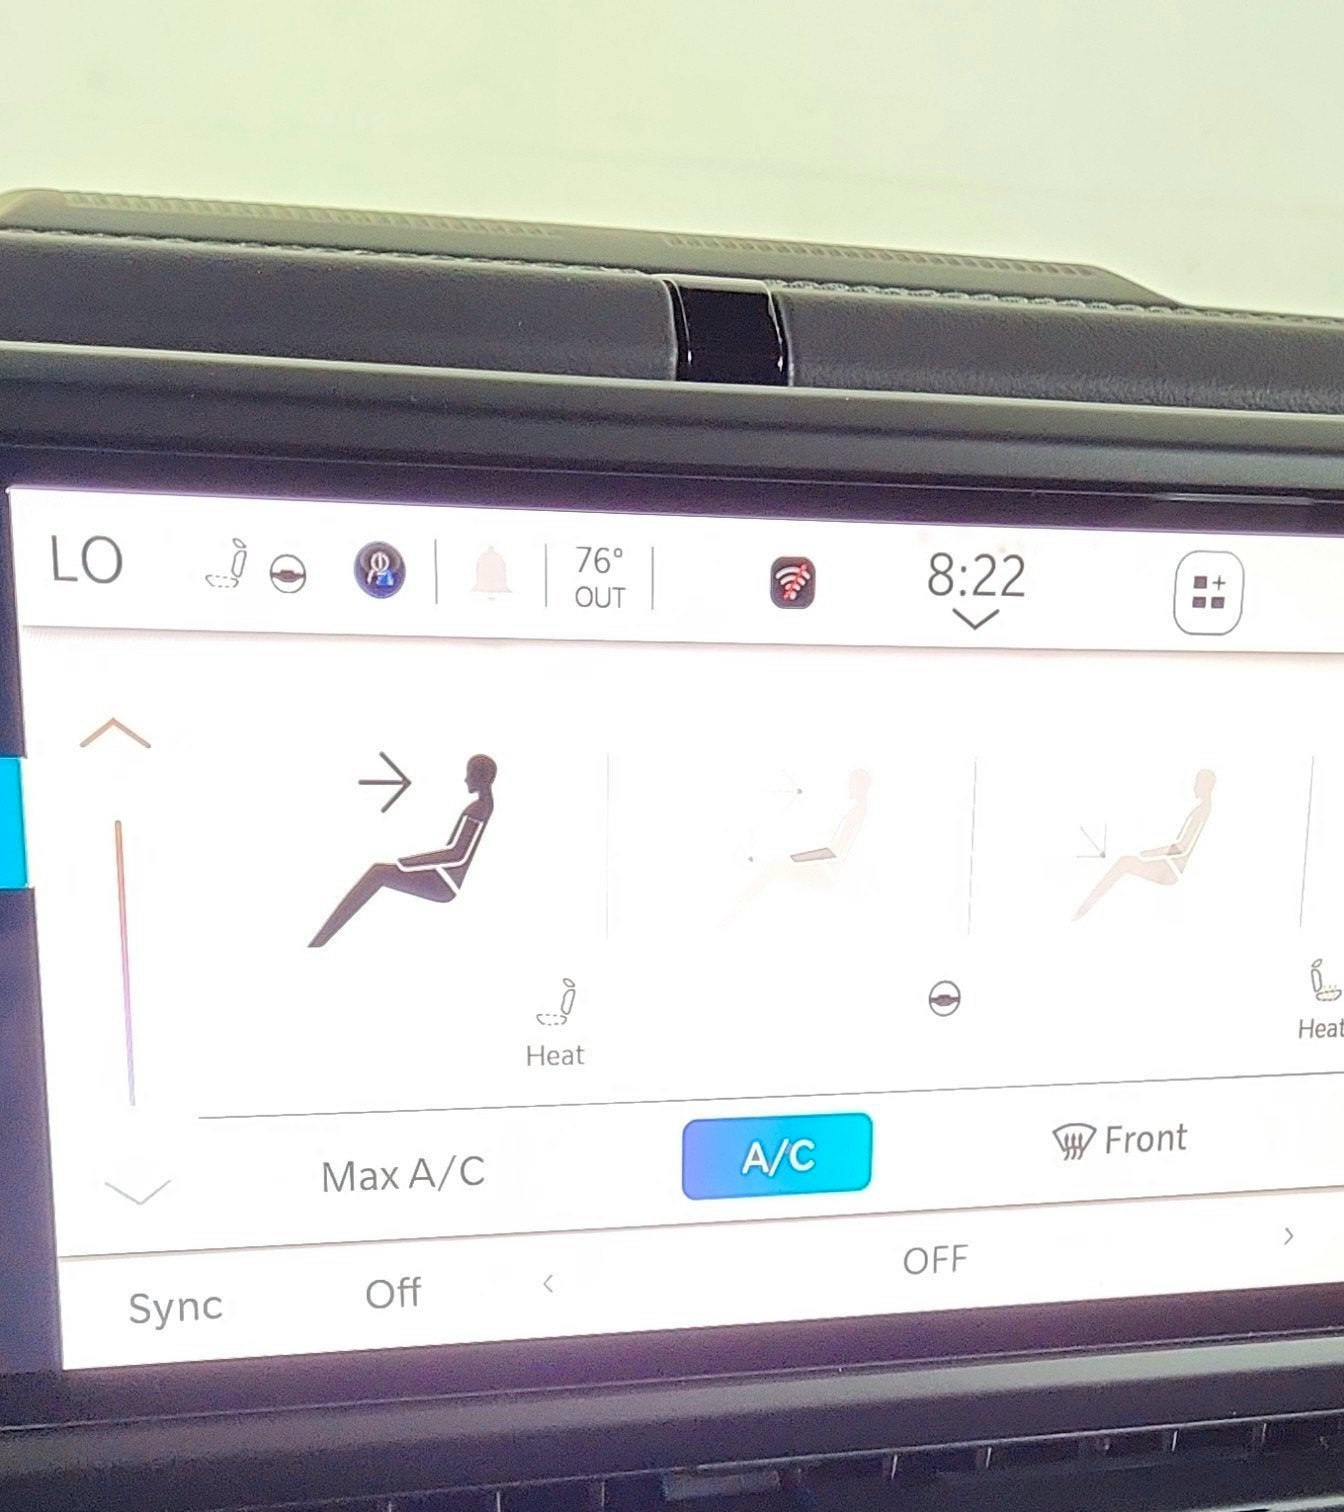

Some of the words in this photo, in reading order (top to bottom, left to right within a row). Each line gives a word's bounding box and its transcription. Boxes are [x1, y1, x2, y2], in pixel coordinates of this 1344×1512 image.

[51, 534, 123, 584] LO
[575, 545, 624, 574] 76°
[927, 552, 1026, 599] 8:22
[574, 586, 627, 609] OUT
[525, 1044, 585, 1068] Heat
[1105, 1122, 1188, 1155] Front
[742, 1138, 816, 1176] A/C
[322, 1161, 398, 1194] Max
[408, 1155, 486, 1192] A/C
[902, 1243, 969, 1276] OFF
[365, 1277, 423, 1310] Off
[128, 1290, 224, 1331] Sync
